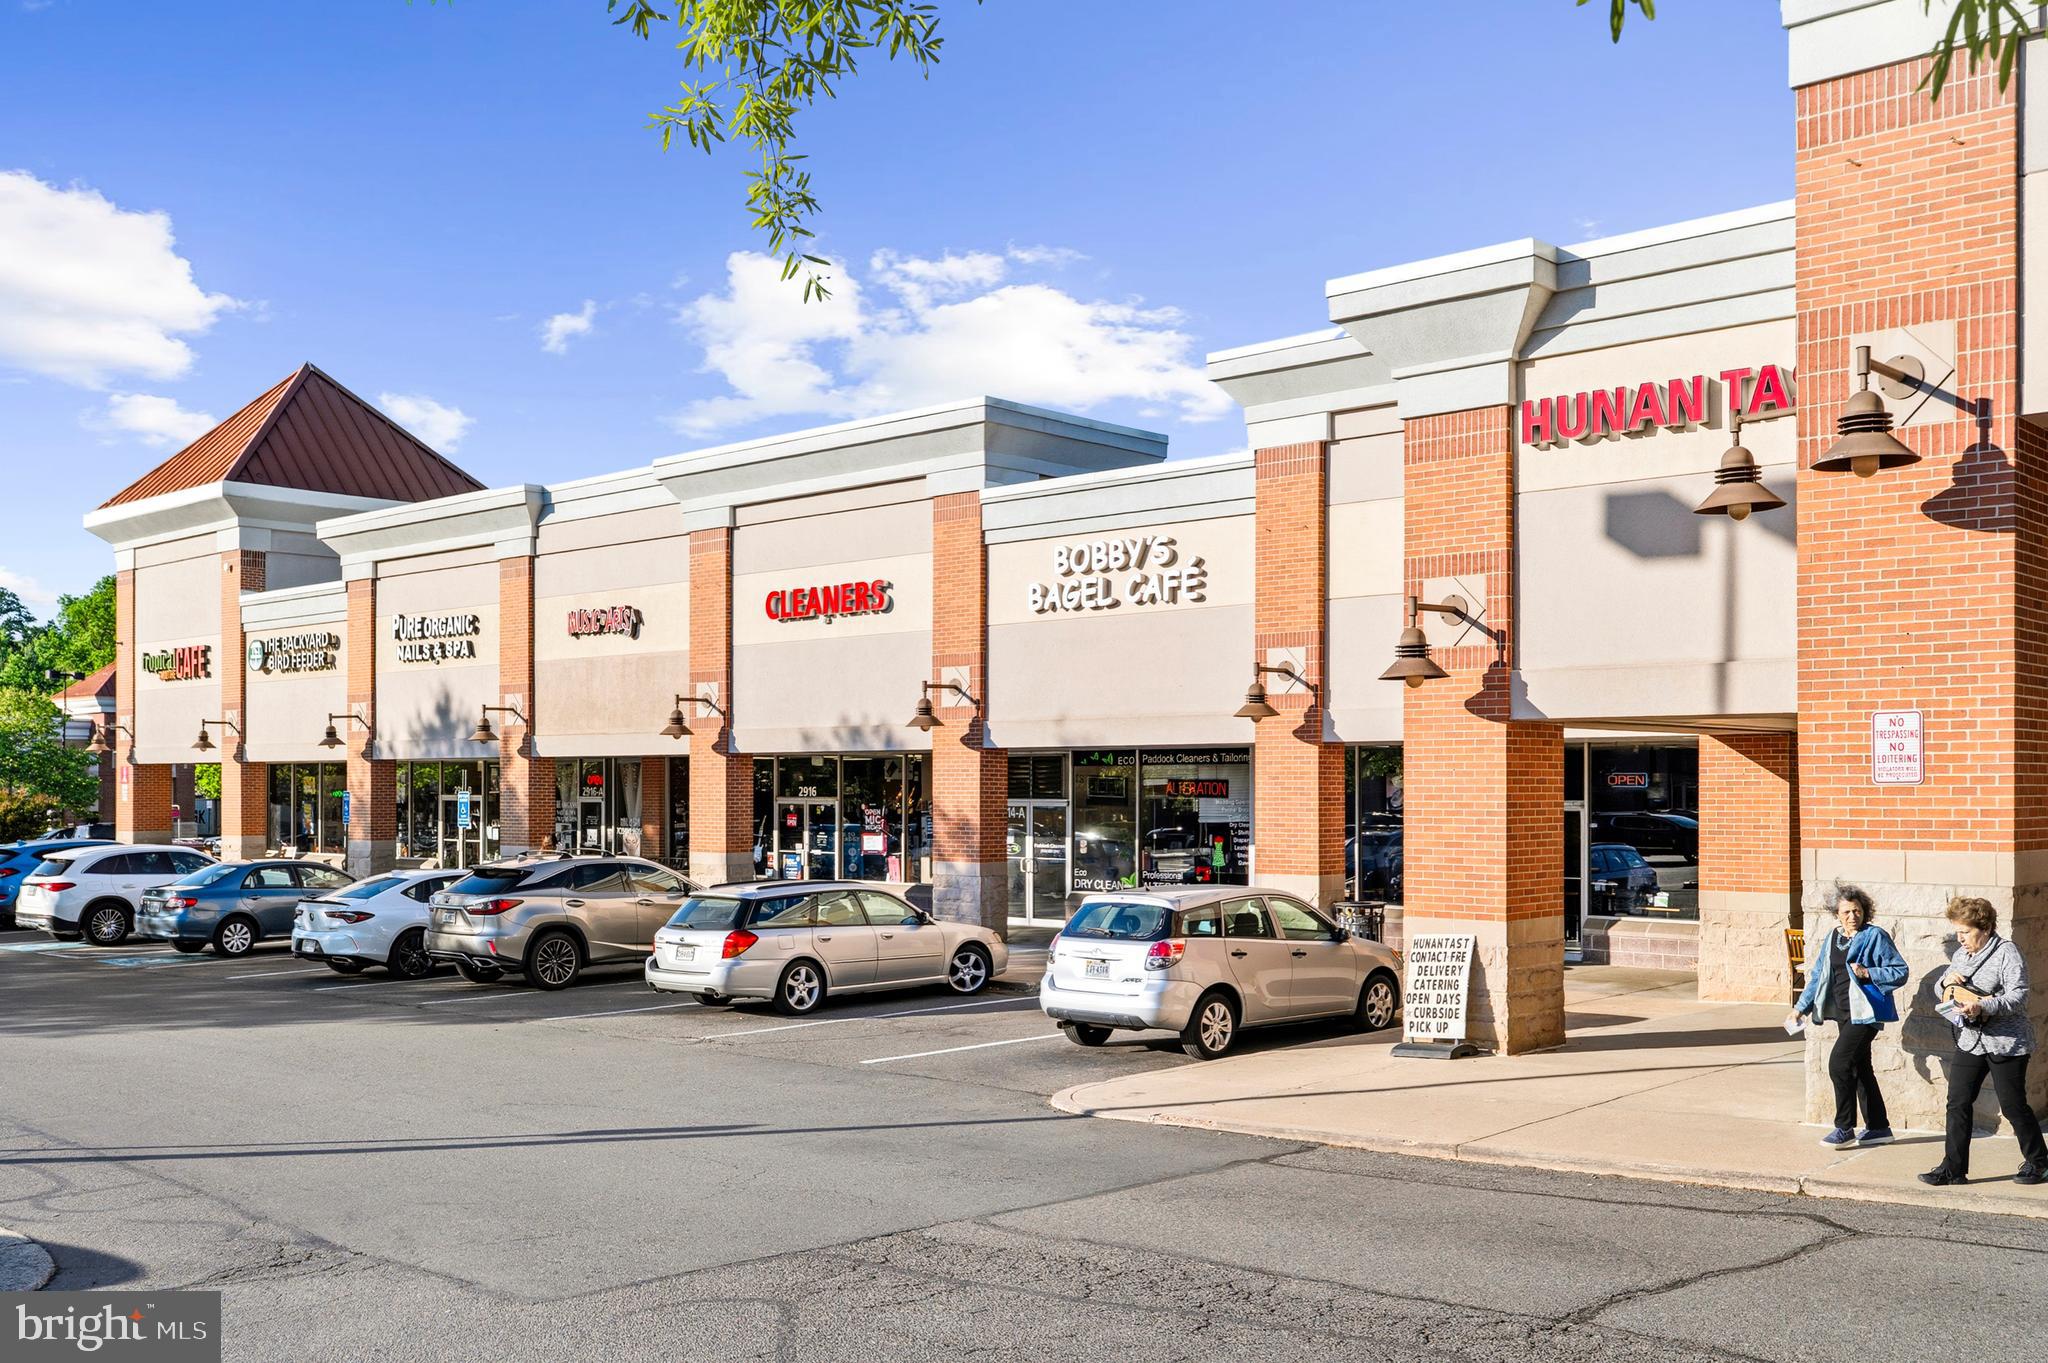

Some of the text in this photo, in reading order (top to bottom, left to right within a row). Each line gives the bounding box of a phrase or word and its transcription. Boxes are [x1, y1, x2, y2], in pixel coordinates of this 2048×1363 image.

[1521, 364, 1797, 445] HUNAN TA
[1053, 535, 1172, 576] BOBBY'S
[1027, 556, 1200, 613] BAGEL CAFÉ
[765, 579, 886, 620] CLEANERS
[392, 614, 475, 641] PURE ORGANIC
[567, 609, 600, 636] MUSIC
[264, 632, 329, 653] THE BACKYARD
[396, 640, 470, 661] NAILS & SPA
[176, 645, 206, 679] CAFE
[268, 653, 291, 671] BIRD
[291, 652, 325, 669] FEEDER
[1889, 718, 1905, 727] NO
[1876, 729, 1919, 740] TRESPASSING
[1889, 742, 1905, 752] NO
[1117, 756, 1135, 765] ECO
[1142, 754, 1175, 763] Paddock
[1176, 753, 1211, 763] Cleaners
[1212, 753, 1219, 763] &
[1877, 754, 1918, 764] LOITERING
[1608, 775, 1645, 785] OPEN
[582, 787, 604, 796] 2916-A
[798, 786, 817, 797] 2916
[1166, 781, 1227, 795] ALTERATION
[865, 815, 882, 825] MIC
[1074, 868, 1087, 877] Eco
[1142, 870, 1184, 880] Professional
[1074, 879, 1123, 890] DRY CLEAN
[1413, 938, 1470, 950] HUNANTAST
[1410, 951, 1448, 963] CONTACT
[1417, 965, 1463, 977] DELIVERY
[1414, 979, 1459, 991] CATERING
[1406, 993, 1461, 1005] OPEN DAYS
[1414, 1007, 1460, 1019] CURBSIDE
[1409, 1021, 1449, 1033] PICK UP
